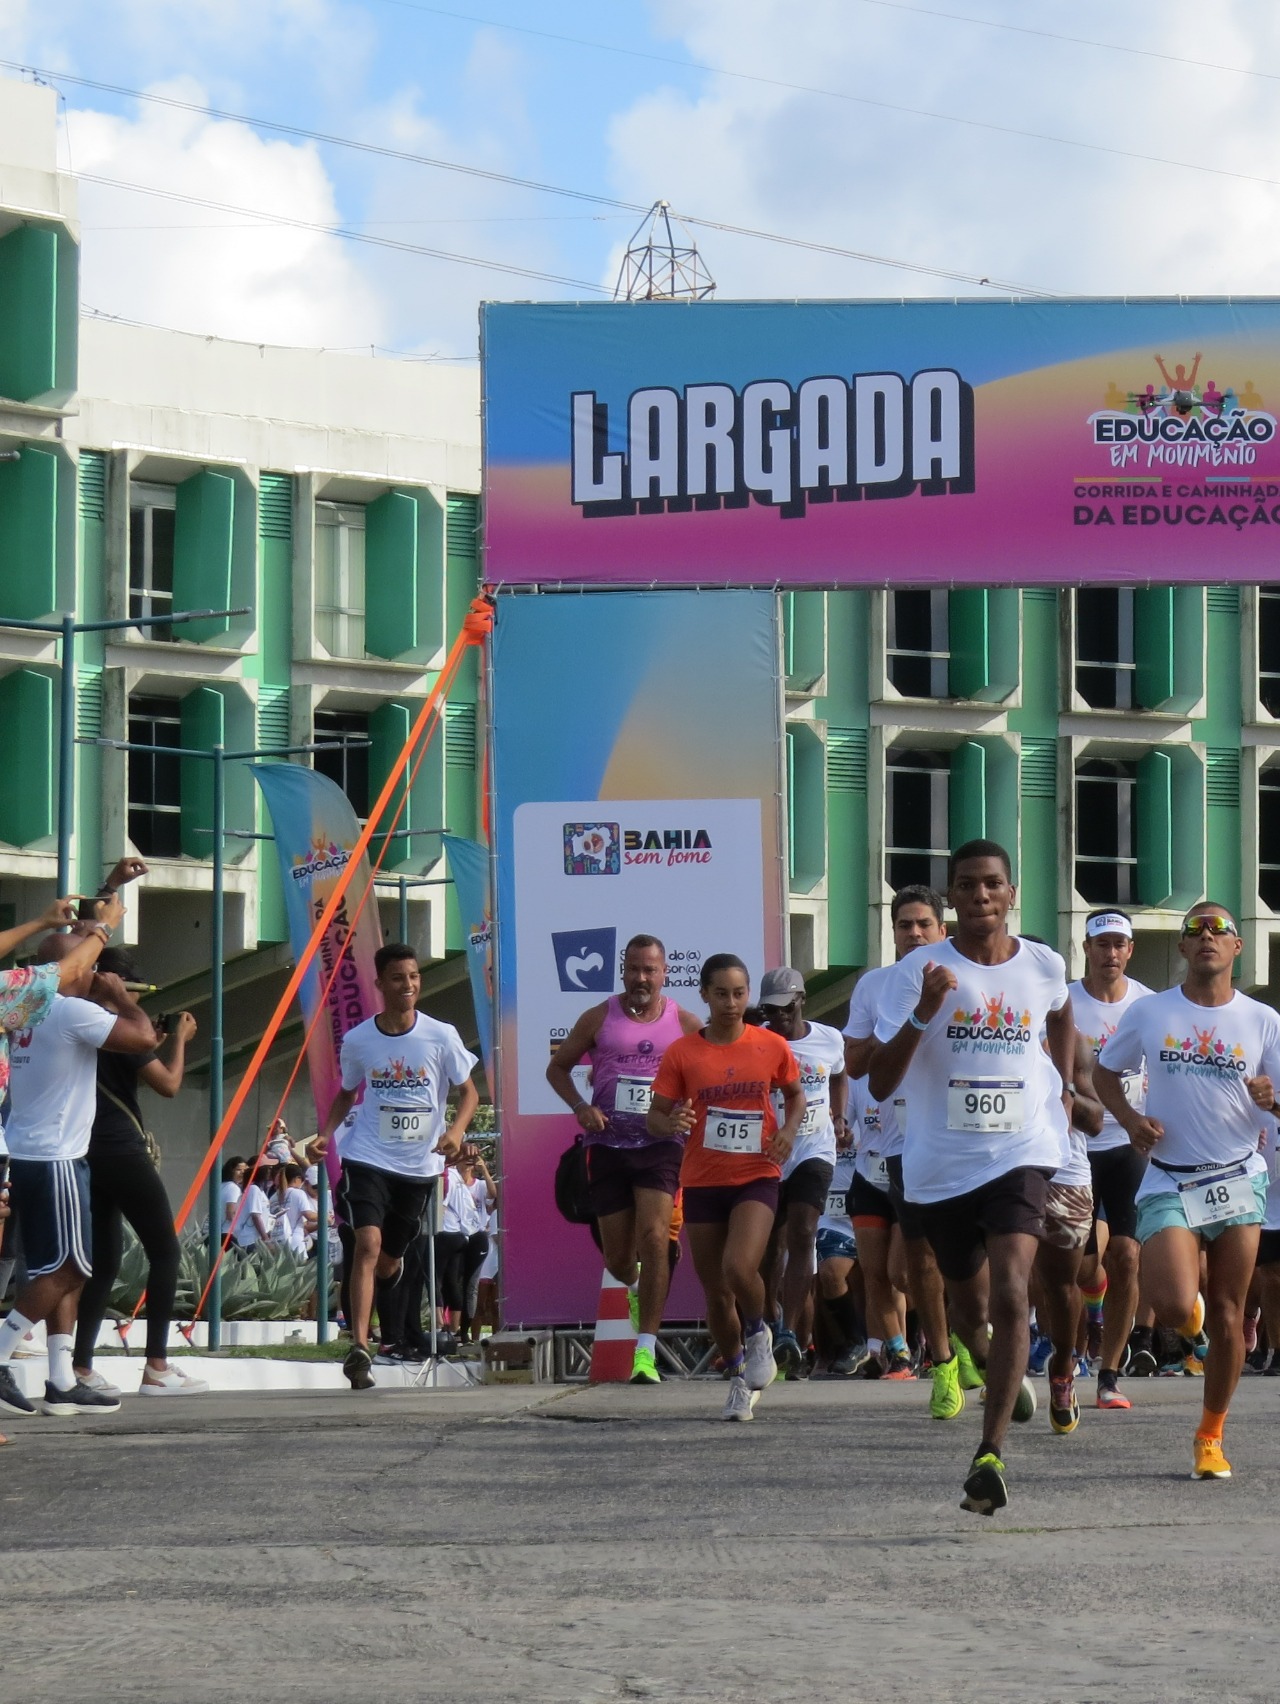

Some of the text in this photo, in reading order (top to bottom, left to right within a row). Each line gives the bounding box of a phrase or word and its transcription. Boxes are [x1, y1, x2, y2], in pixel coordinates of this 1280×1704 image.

[1096, 411, 1273, 448] EDUCAÇÃO
[571, 368, 975, 518] LARGADA
[1110, 442, 1256, 467] EM MOVIMENTO
[1074, 485, 1157, 498] CORRIDA
[1162, 485, 1171, 497] E
[1073, 506, 1115, 525] DA
[624, 829, 712, 850] BAHIA
[623, 847, 712, 867] sem fome
[314, 897, 337, 993] CAMINHDA
[946, 1024, 1031, 1045] EDUCAÇÃO
[951, 1041, 1025, 1055] EM MOVIMENTO
[1160, 1050, 1246, 1071] EDUCAÇÃO
[371, 1076, 430, 1090] EDUCAÇÃO
[800, 1073, 826, 1086] AÇÃO
[964, 1093, 1006, 1114] 960
[391, 1115, 420, 1130] 900
[801, 1109, 816, 1123] 97
[716, 1122, 749, 1139] 615
[829, 1197, 844, 1208] 73
[1204, 1186, 1230, 1206] 48
